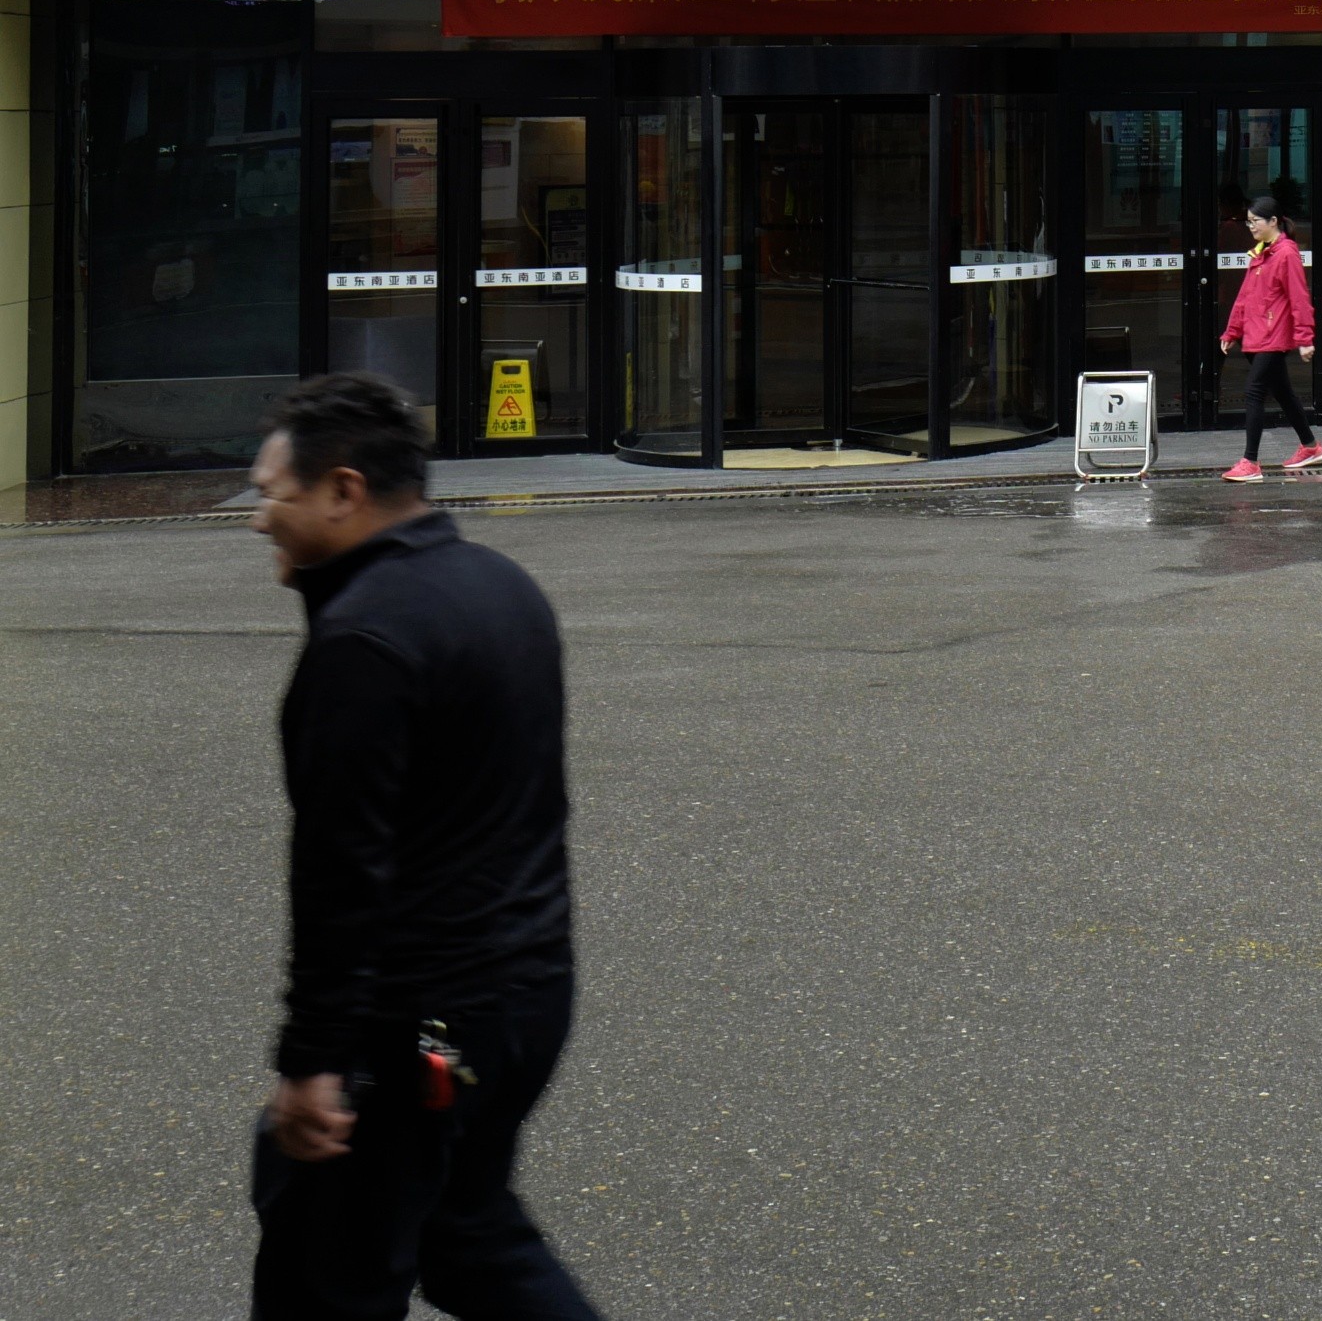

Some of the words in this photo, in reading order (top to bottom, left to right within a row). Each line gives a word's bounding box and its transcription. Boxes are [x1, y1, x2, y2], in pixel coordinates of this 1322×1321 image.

[1091, 256, 1178, 270] 亚东南亚酒店
[336, 273, 435, 287] 亚东南亚酒店
[484, 270, 580, 284] 亚东南亚酒店
[492, 418, 527, 432] 小心地滑
[1089, 420, 1140, 432] 请勿泊车
[1088, 433, 1100, 444] NO
[1102, 432, 1138, 444] PARKING
